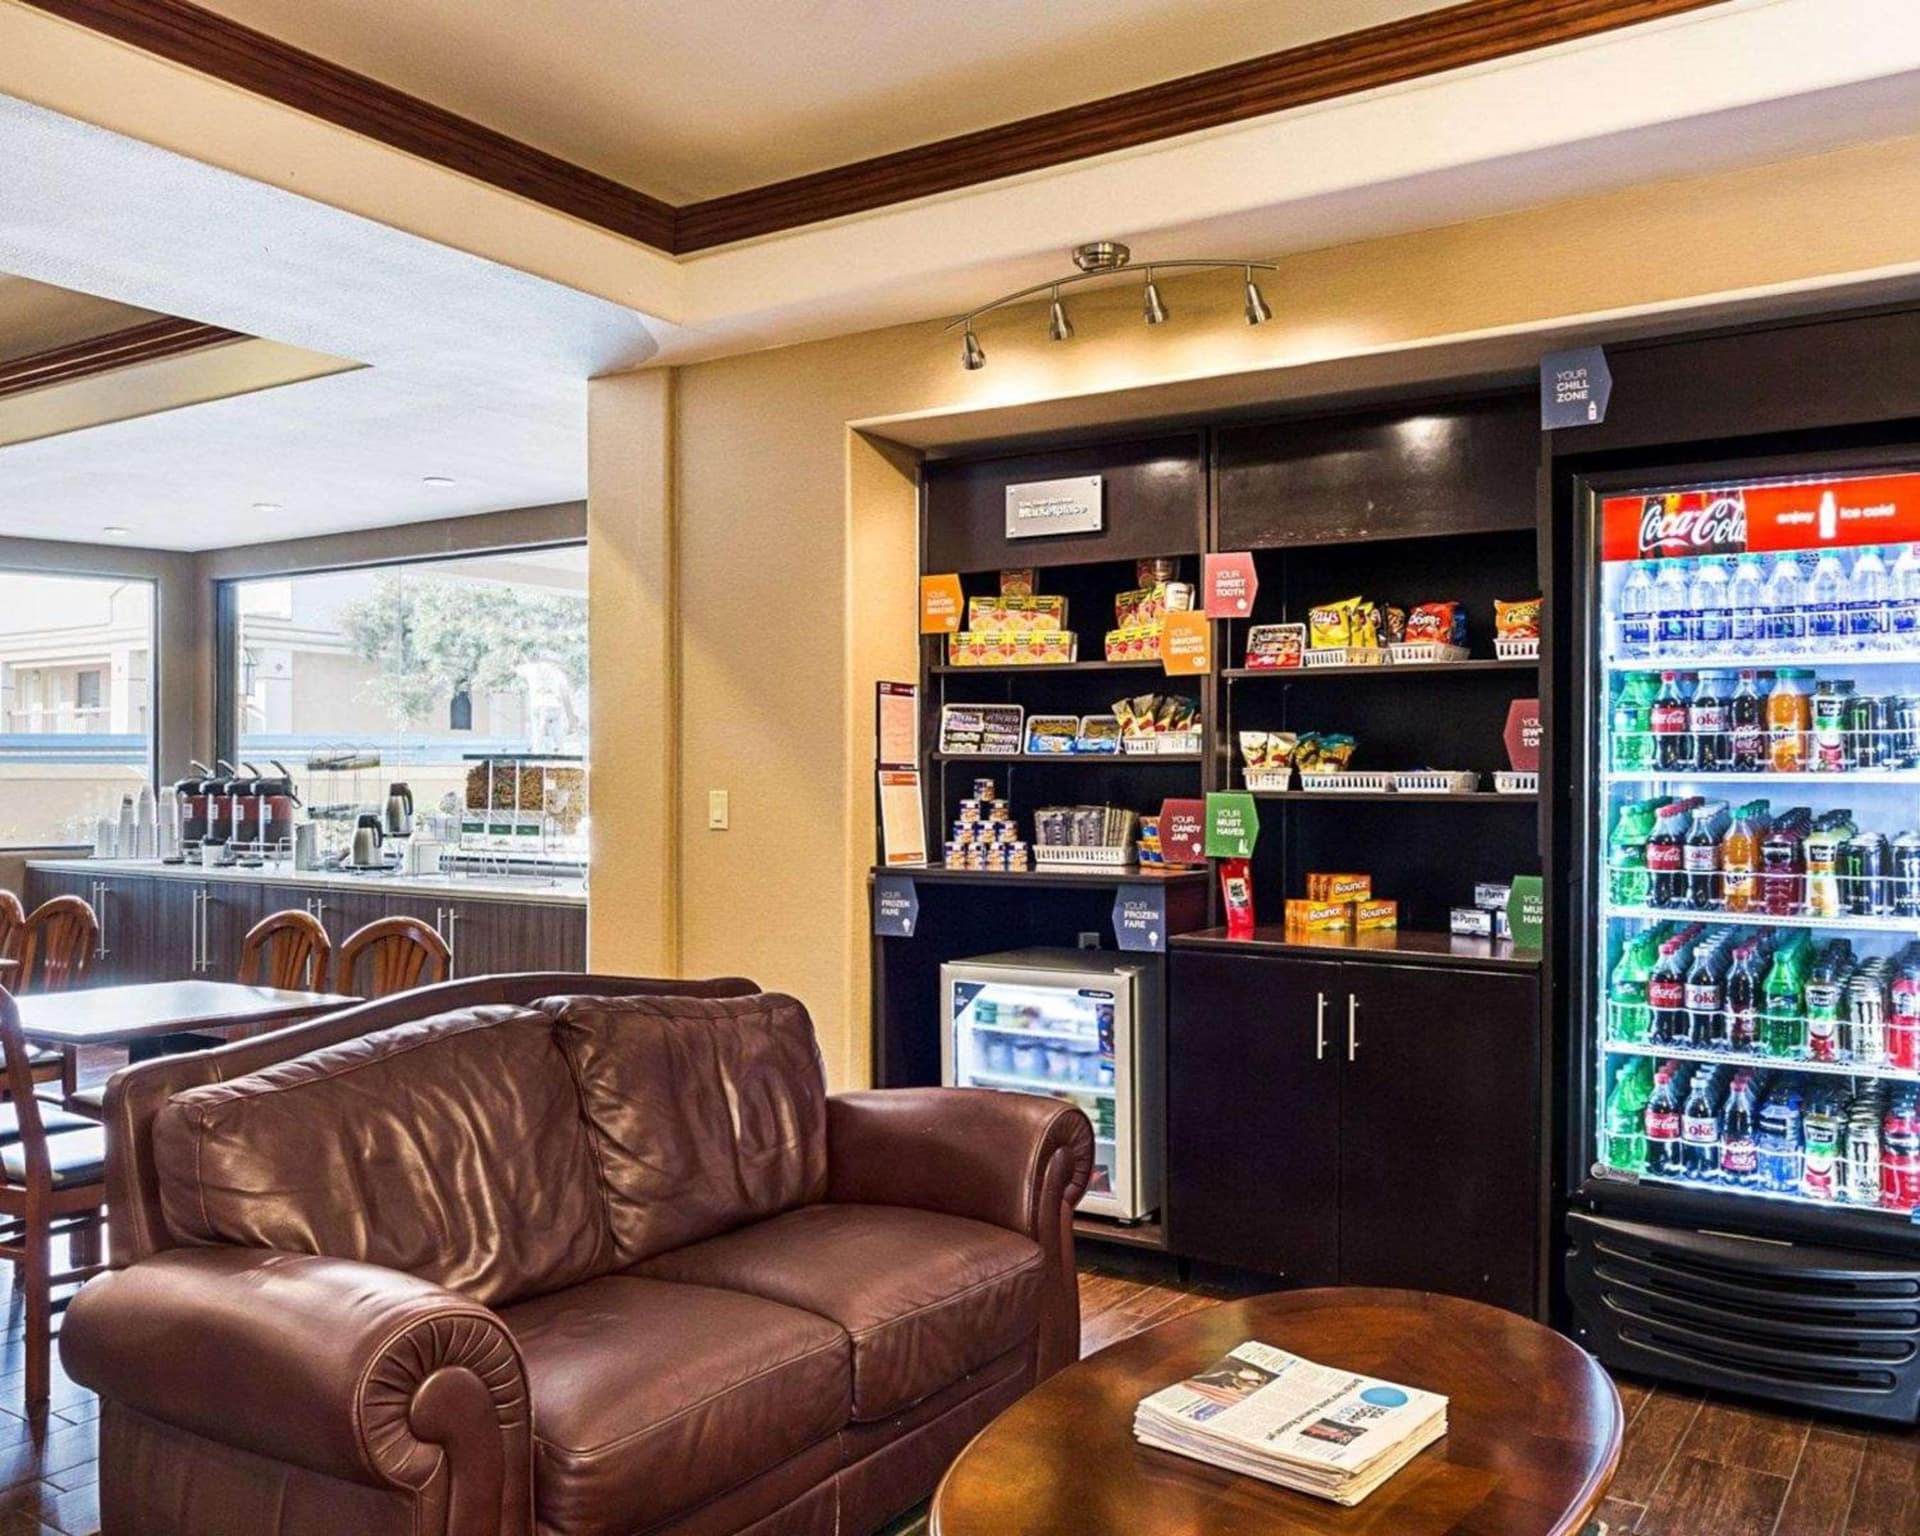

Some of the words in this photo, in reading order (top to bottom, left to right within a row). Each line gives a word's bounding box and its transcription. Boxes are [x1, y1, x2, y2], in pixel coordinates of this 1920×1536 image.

[1557, 368, 1588, 383] YOUR
[1557, 379, 1590, 393] CHILL
[1557, 390, 1588, 403] ZONE
[1776, 511, 1815, 525] enjoy
[1863, 503, 1896, 518] cold
[1639, 498, 1747, 550] Coca-Cola
[1216, 579, 1246, 588] SWEET
[1216, 588, 1246, 597] TOOTH
[1692, 712, 1723, 726] oke
[1217, 809, 1241, 818] YOUR
[1172, 815, 1195, 824] YOUR
[1216, 818, 1242, 827] MUST
[1172, 824, 1202, 833] CANDY
[1217, 827, 1245, 836] HAVES
[1171, 833, 1189, 841] JAR
[1335, 880, 1369, 894] Bounce
[881, 899, 911, 909] FROZEN
[1124, 902, 1148, 910] YOUR
[881, 908, 900, 917] FARE
[1124, 911, 1159, 921] FROZEN
[1309, 907, 1342, 921] Bounce
[1359, 905, 1393, 920] Bounce
[1124, 920, 1147, 929] FARE
[1686, 1123, 1714, 1137] oke
